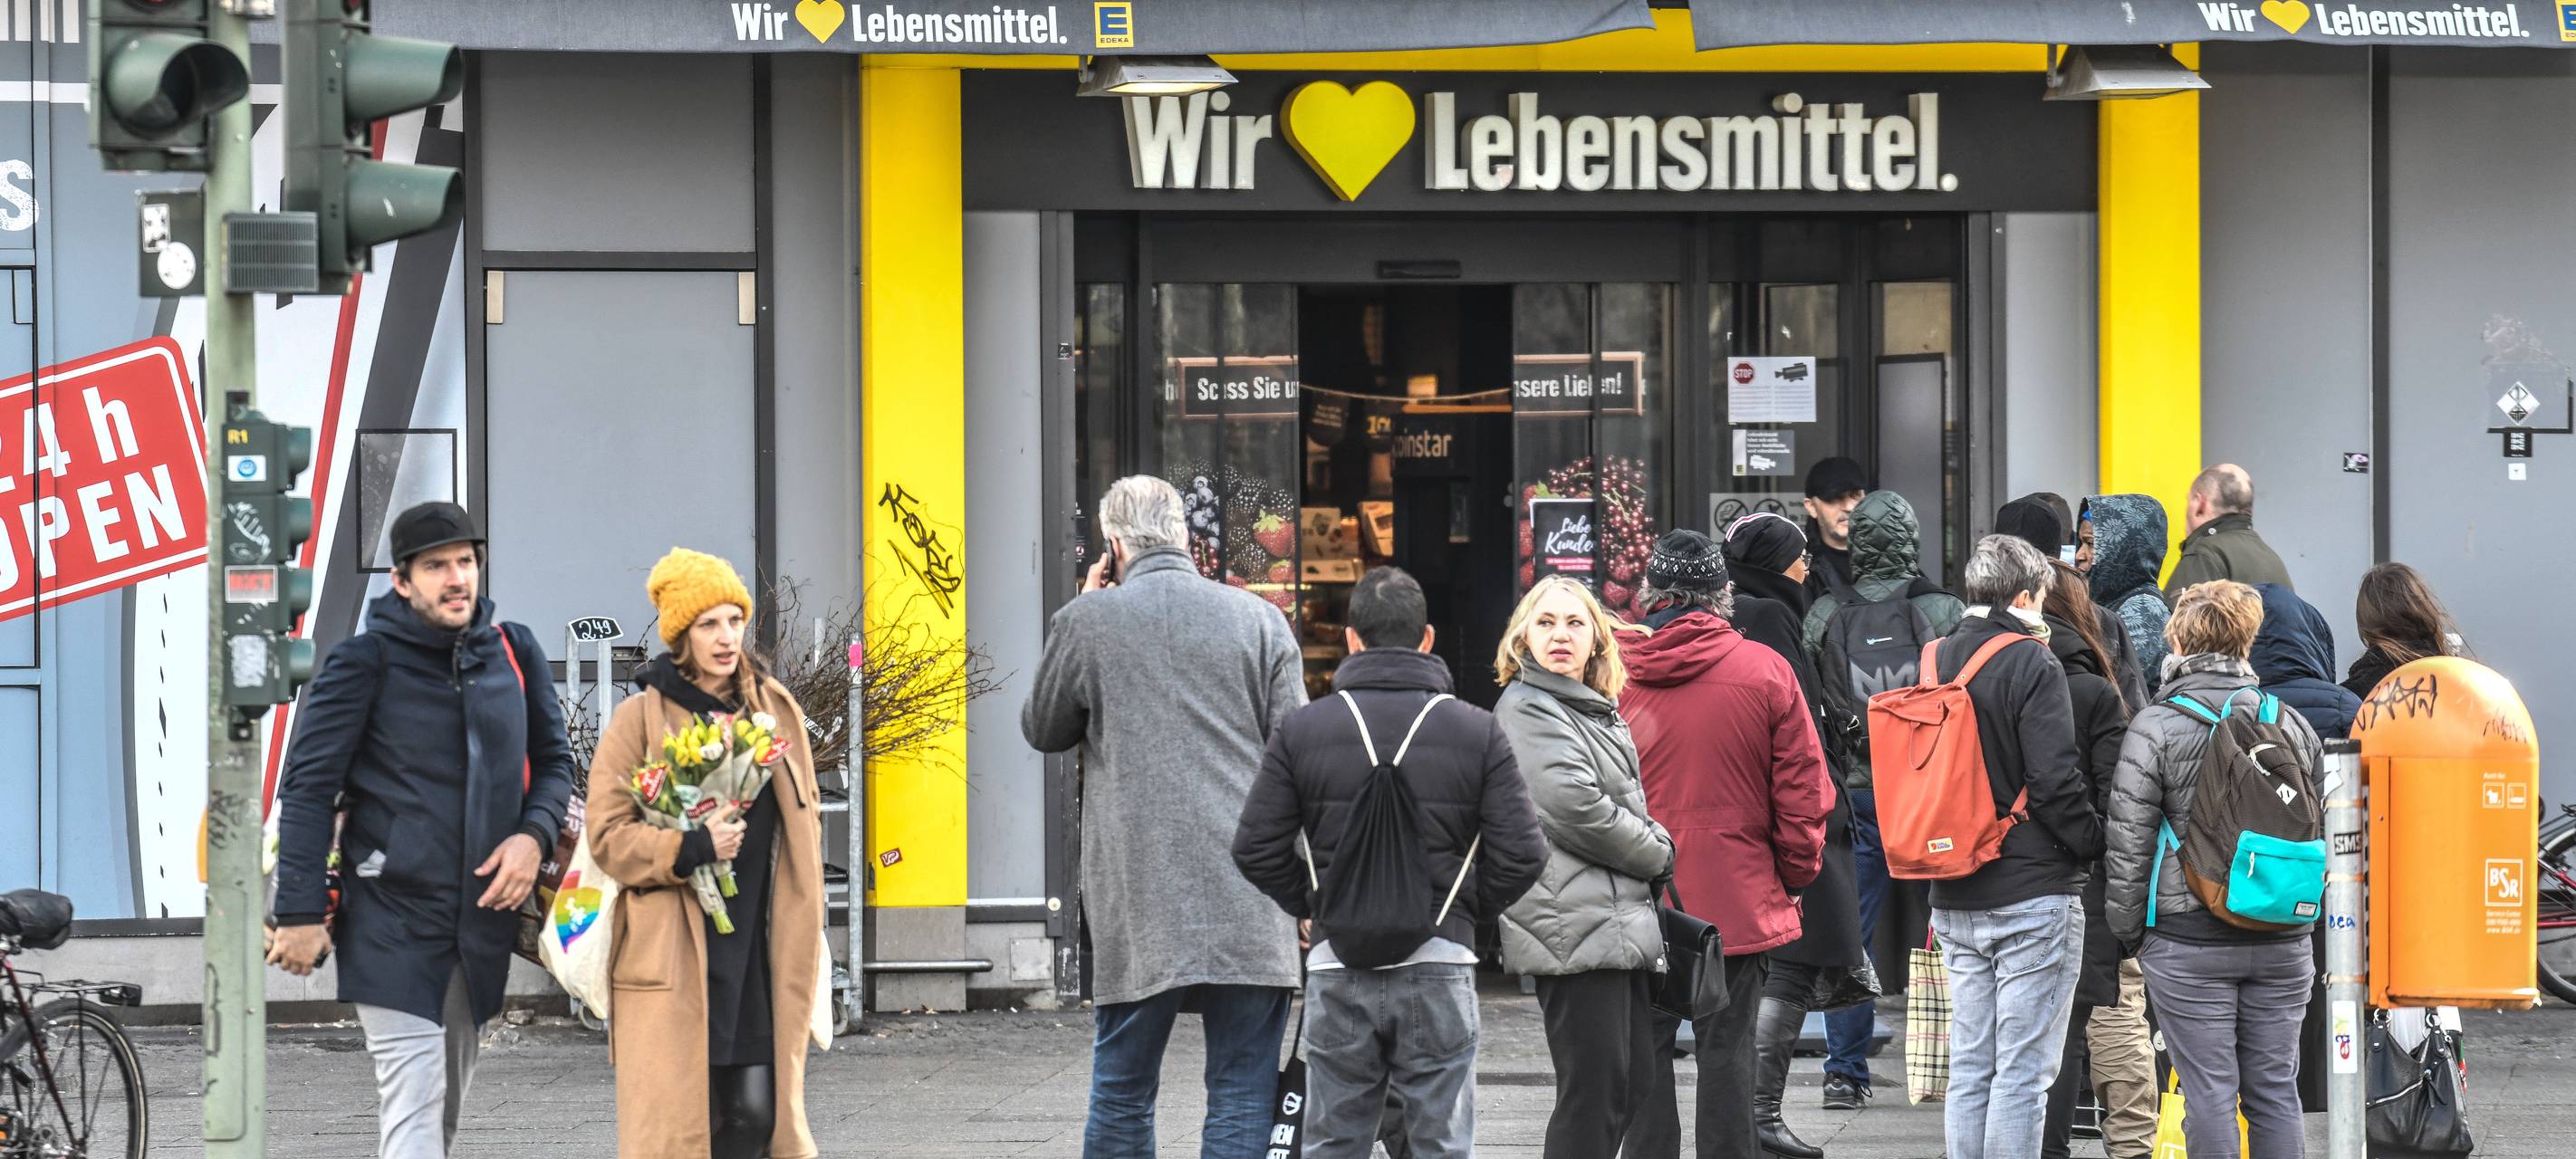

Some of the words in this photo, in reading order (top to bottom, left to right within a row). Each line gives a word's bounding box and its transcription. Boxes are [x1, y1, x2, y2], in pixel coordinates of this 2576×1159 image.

[731, 3, 788, 41] Wir
[851, 4, 1068, 44] Lebensmittel.
[1100, 7, 1128, 34] E
[2196, 2, 2256, 32] Wir
[2314, 3, 2530, 38] Lebensmittel.
[1121, 91, 1273, 190] Wir
[1425, 91, 1959, 192] Lebensmittel.
[1734, 369, 1754, 378] STOP
[1253, 376, 1281, 399] Sie
[0, 402, 72, 494] 4
[82, 386, 140, 465] h
[227, 428, 248, 445] R1
[1560, 514, 1592, 534] Liebe
[1544, 532, 1595, 555] Kunde
[2489, 867, 2519, 898] BSR
